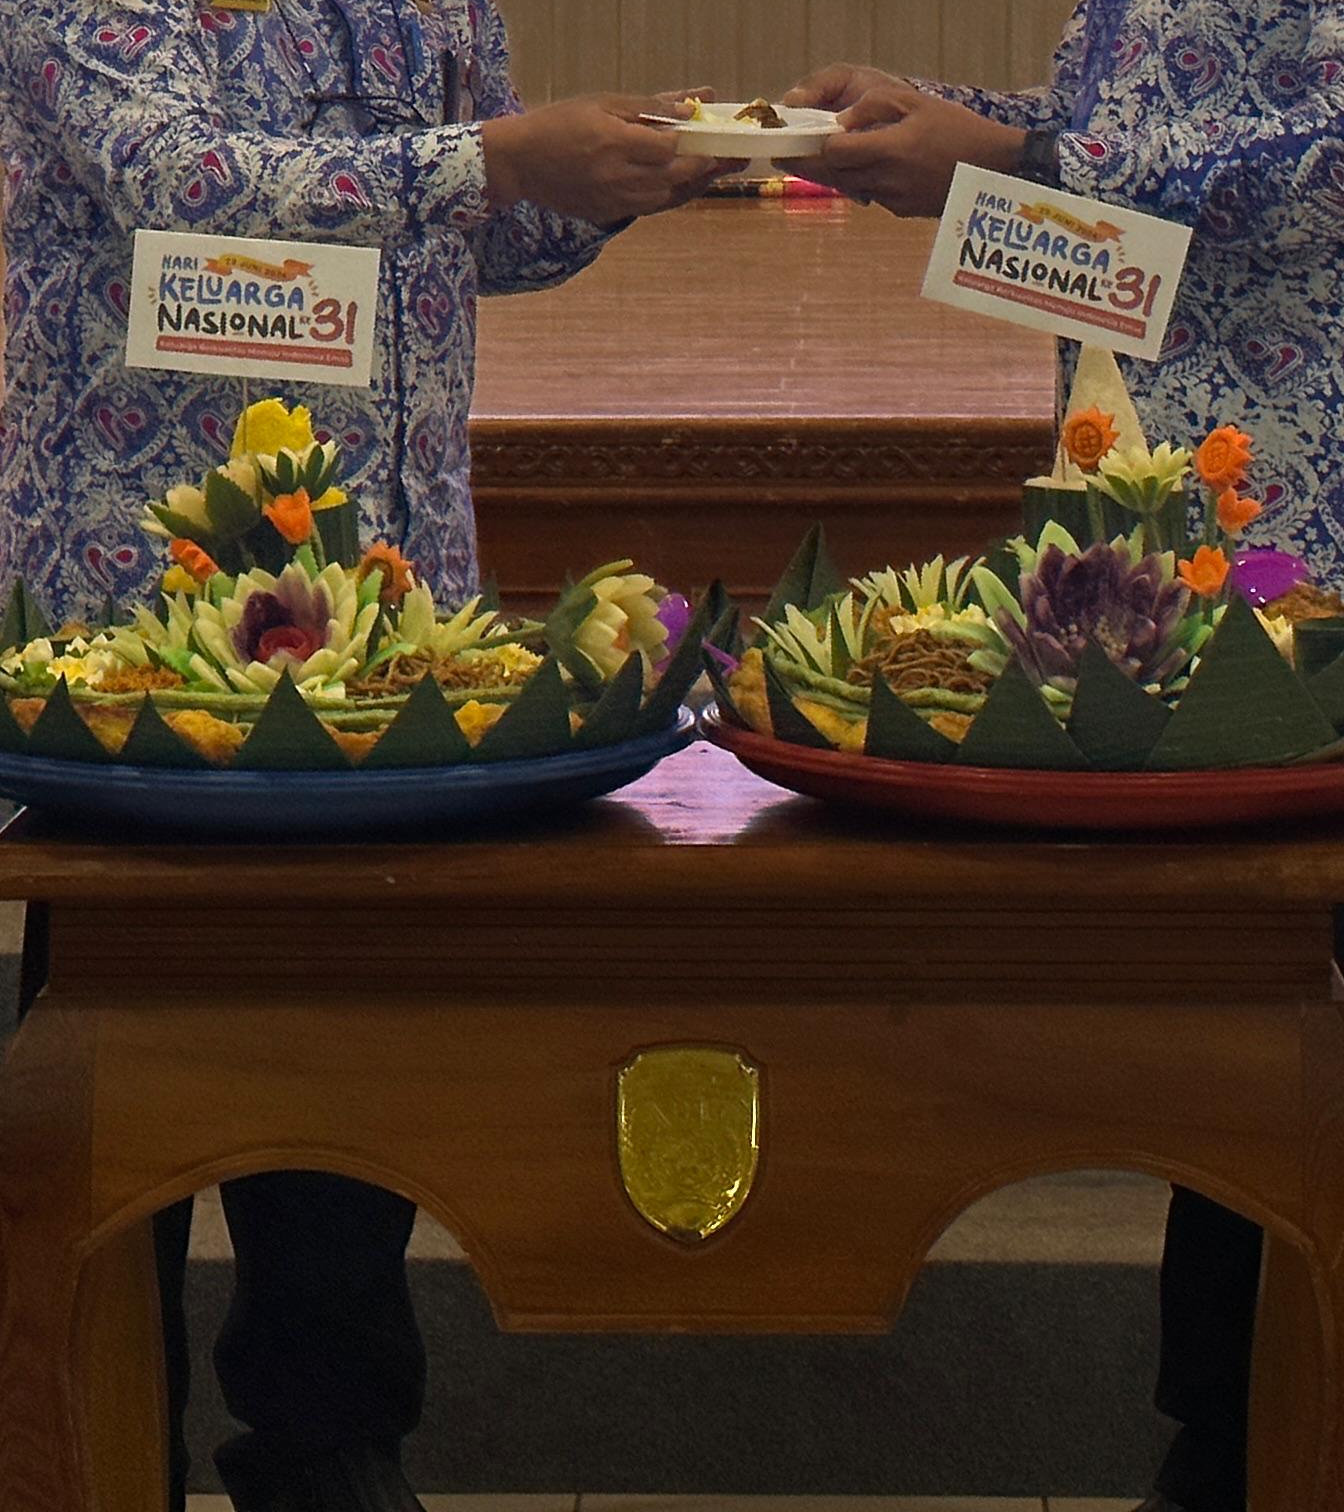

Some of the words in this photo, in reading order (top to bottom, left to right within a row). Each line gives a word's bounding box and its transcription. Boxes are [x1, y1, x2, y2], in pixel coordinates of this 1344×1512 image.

[974, 190, 1013, 213] HARI
[966, 208, 1111, 274] KELUARGA
[162, 254, 199, 272] HARI
[959, 237, 1103, 302] NASIONAL
[1108, 266, 1161, 318] 31
[158, 271, 305, 311] KELUARGA
[157, 303, 305, 340] NASIONAL
[308, 298, 358, 345] 31
